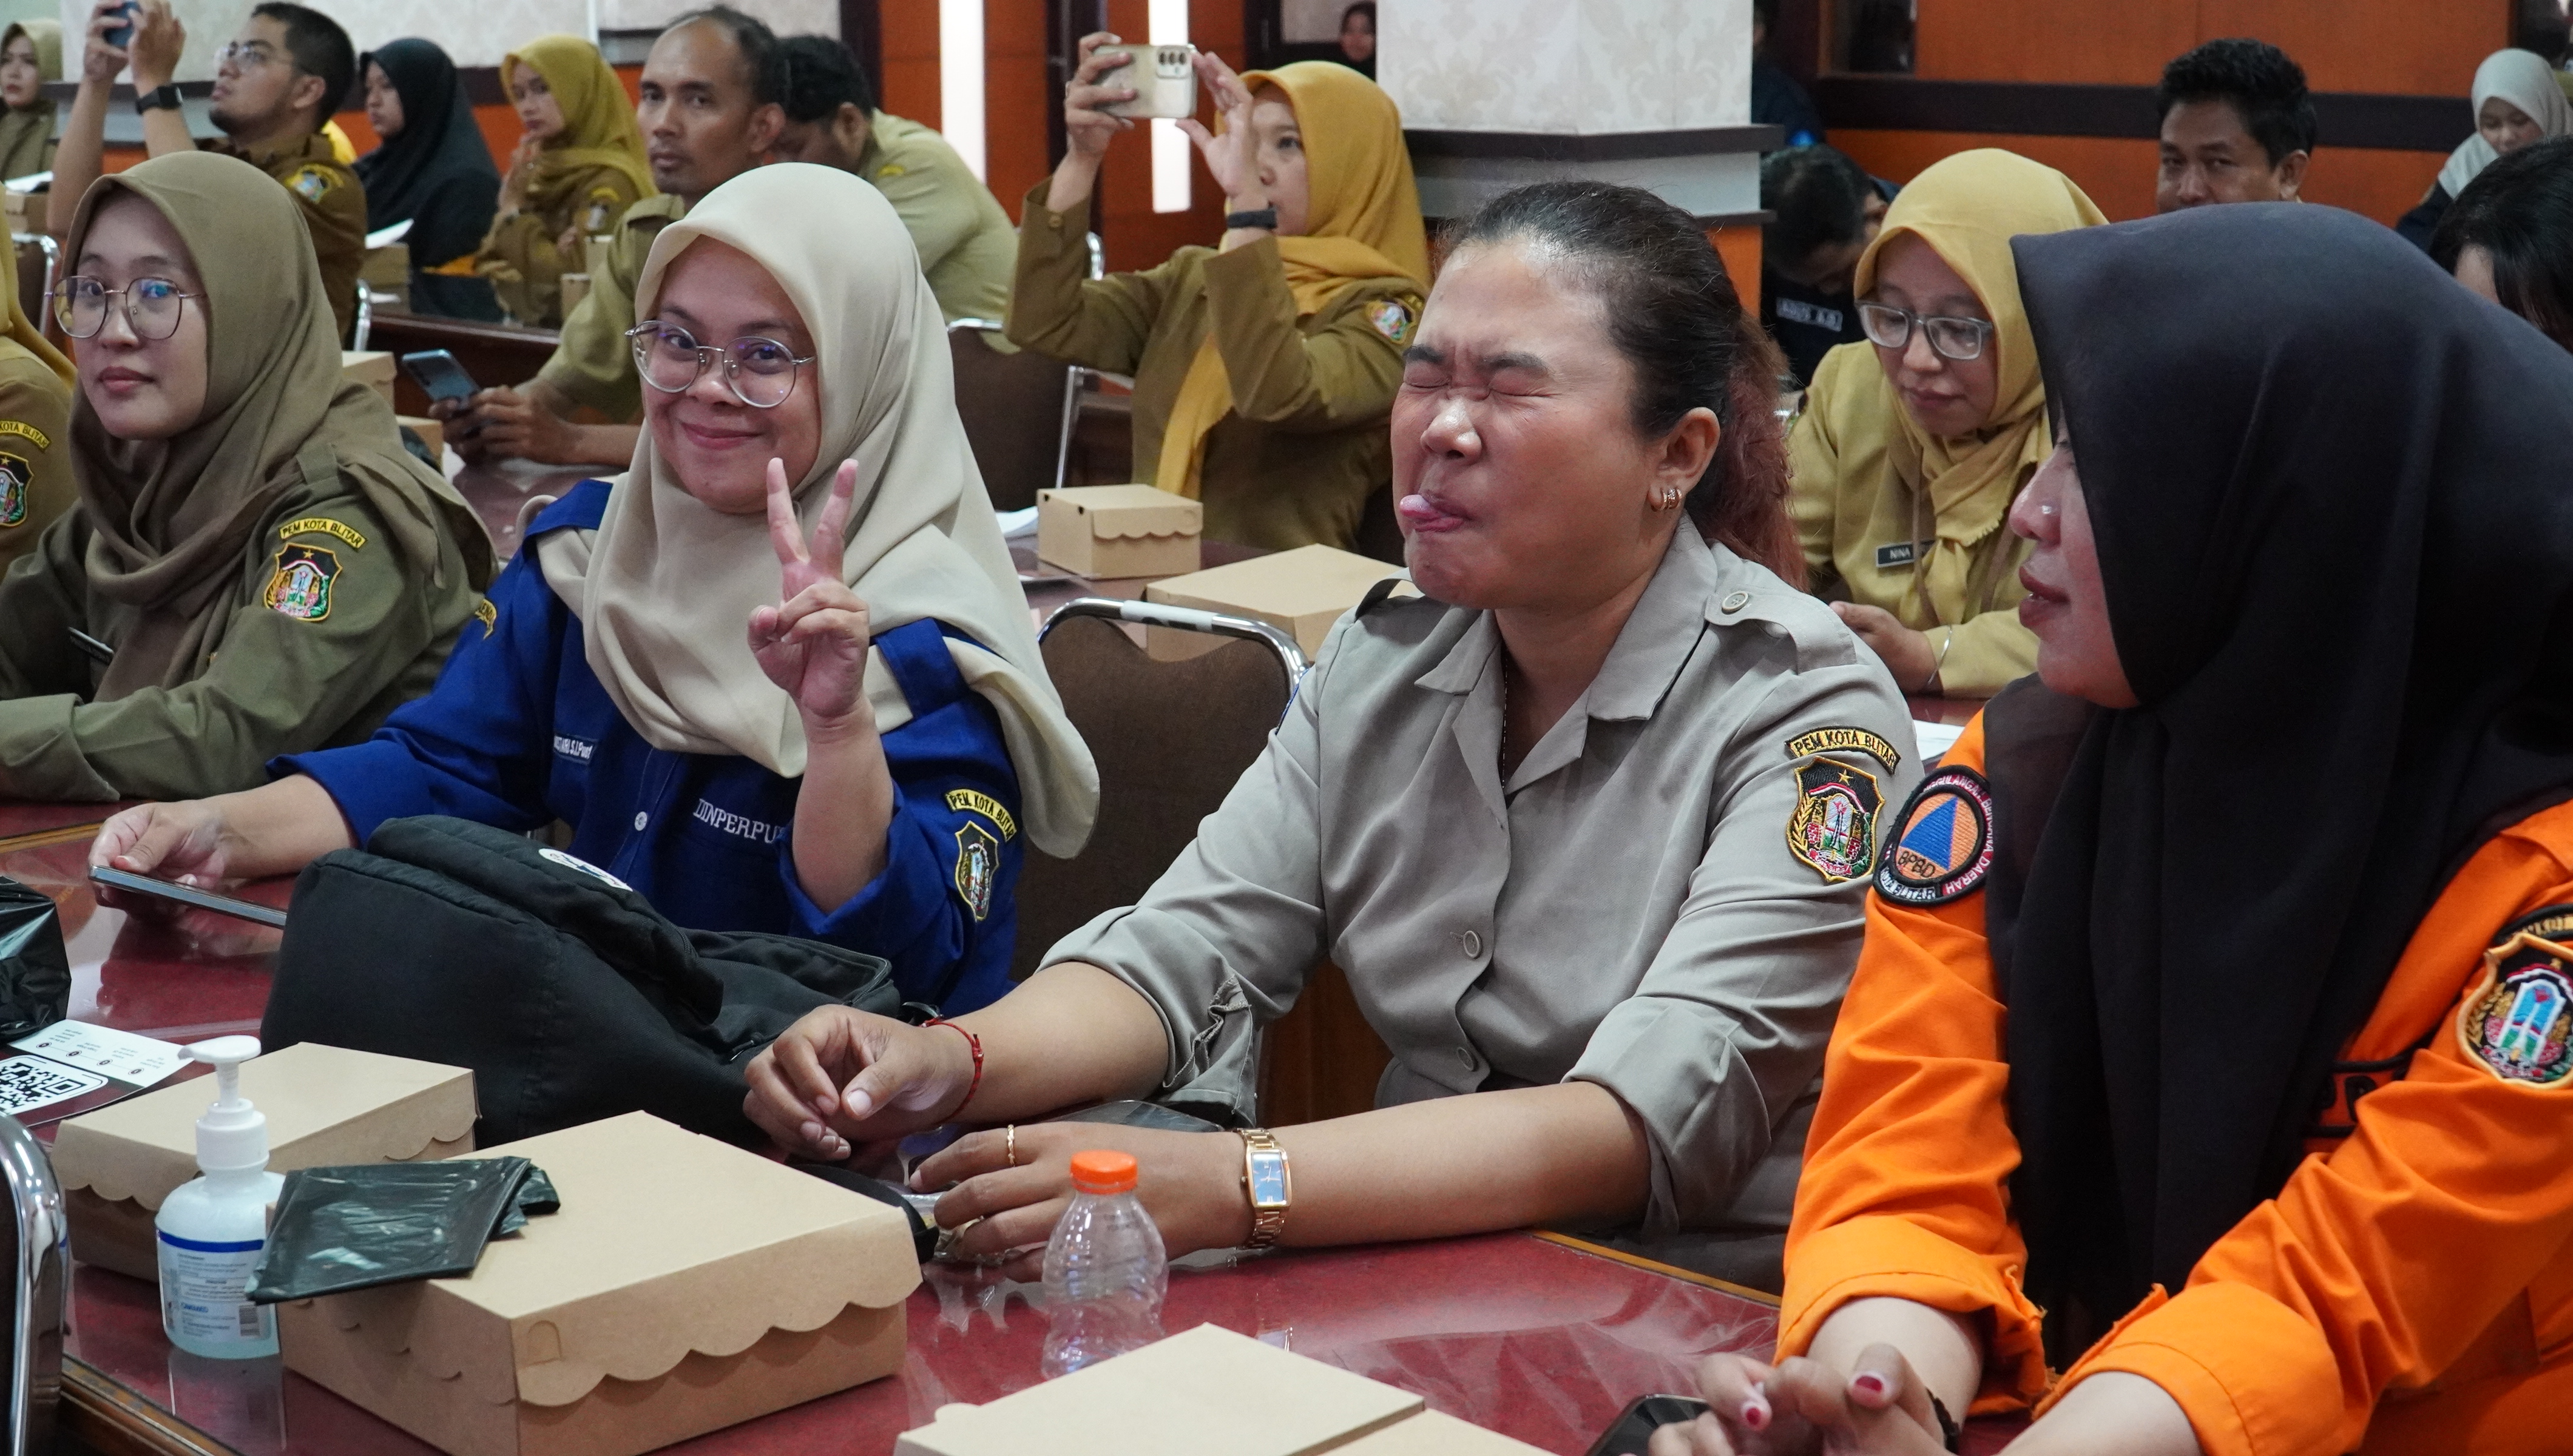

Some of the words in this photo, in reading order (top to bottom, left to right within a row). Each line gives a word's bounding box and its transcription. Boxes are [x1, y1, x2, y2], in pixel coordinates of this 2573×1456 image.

[22, 425, 48, 447] BLITAR
[282, 522, 300, 536] PEM
[303, 520, 327, 530] KOTA
[330, 522, 362, 546] BLITAR
[1794, 732, 1824, 754] PEM
[1825, 730, 1860, 747] KOTA
[1864, 735, 1896, 766] BLITAR
[692, 798, 782, 844] DINPERPU
[974, 794, 994, 816] KOTA
[995, 808, 1014, 838] BLITAR
[1897, 849, 1936, 878] BPBD
[1946, 855, 1991, 894] DAERAH
[1893, 883, 1936, 900] BLITAR
